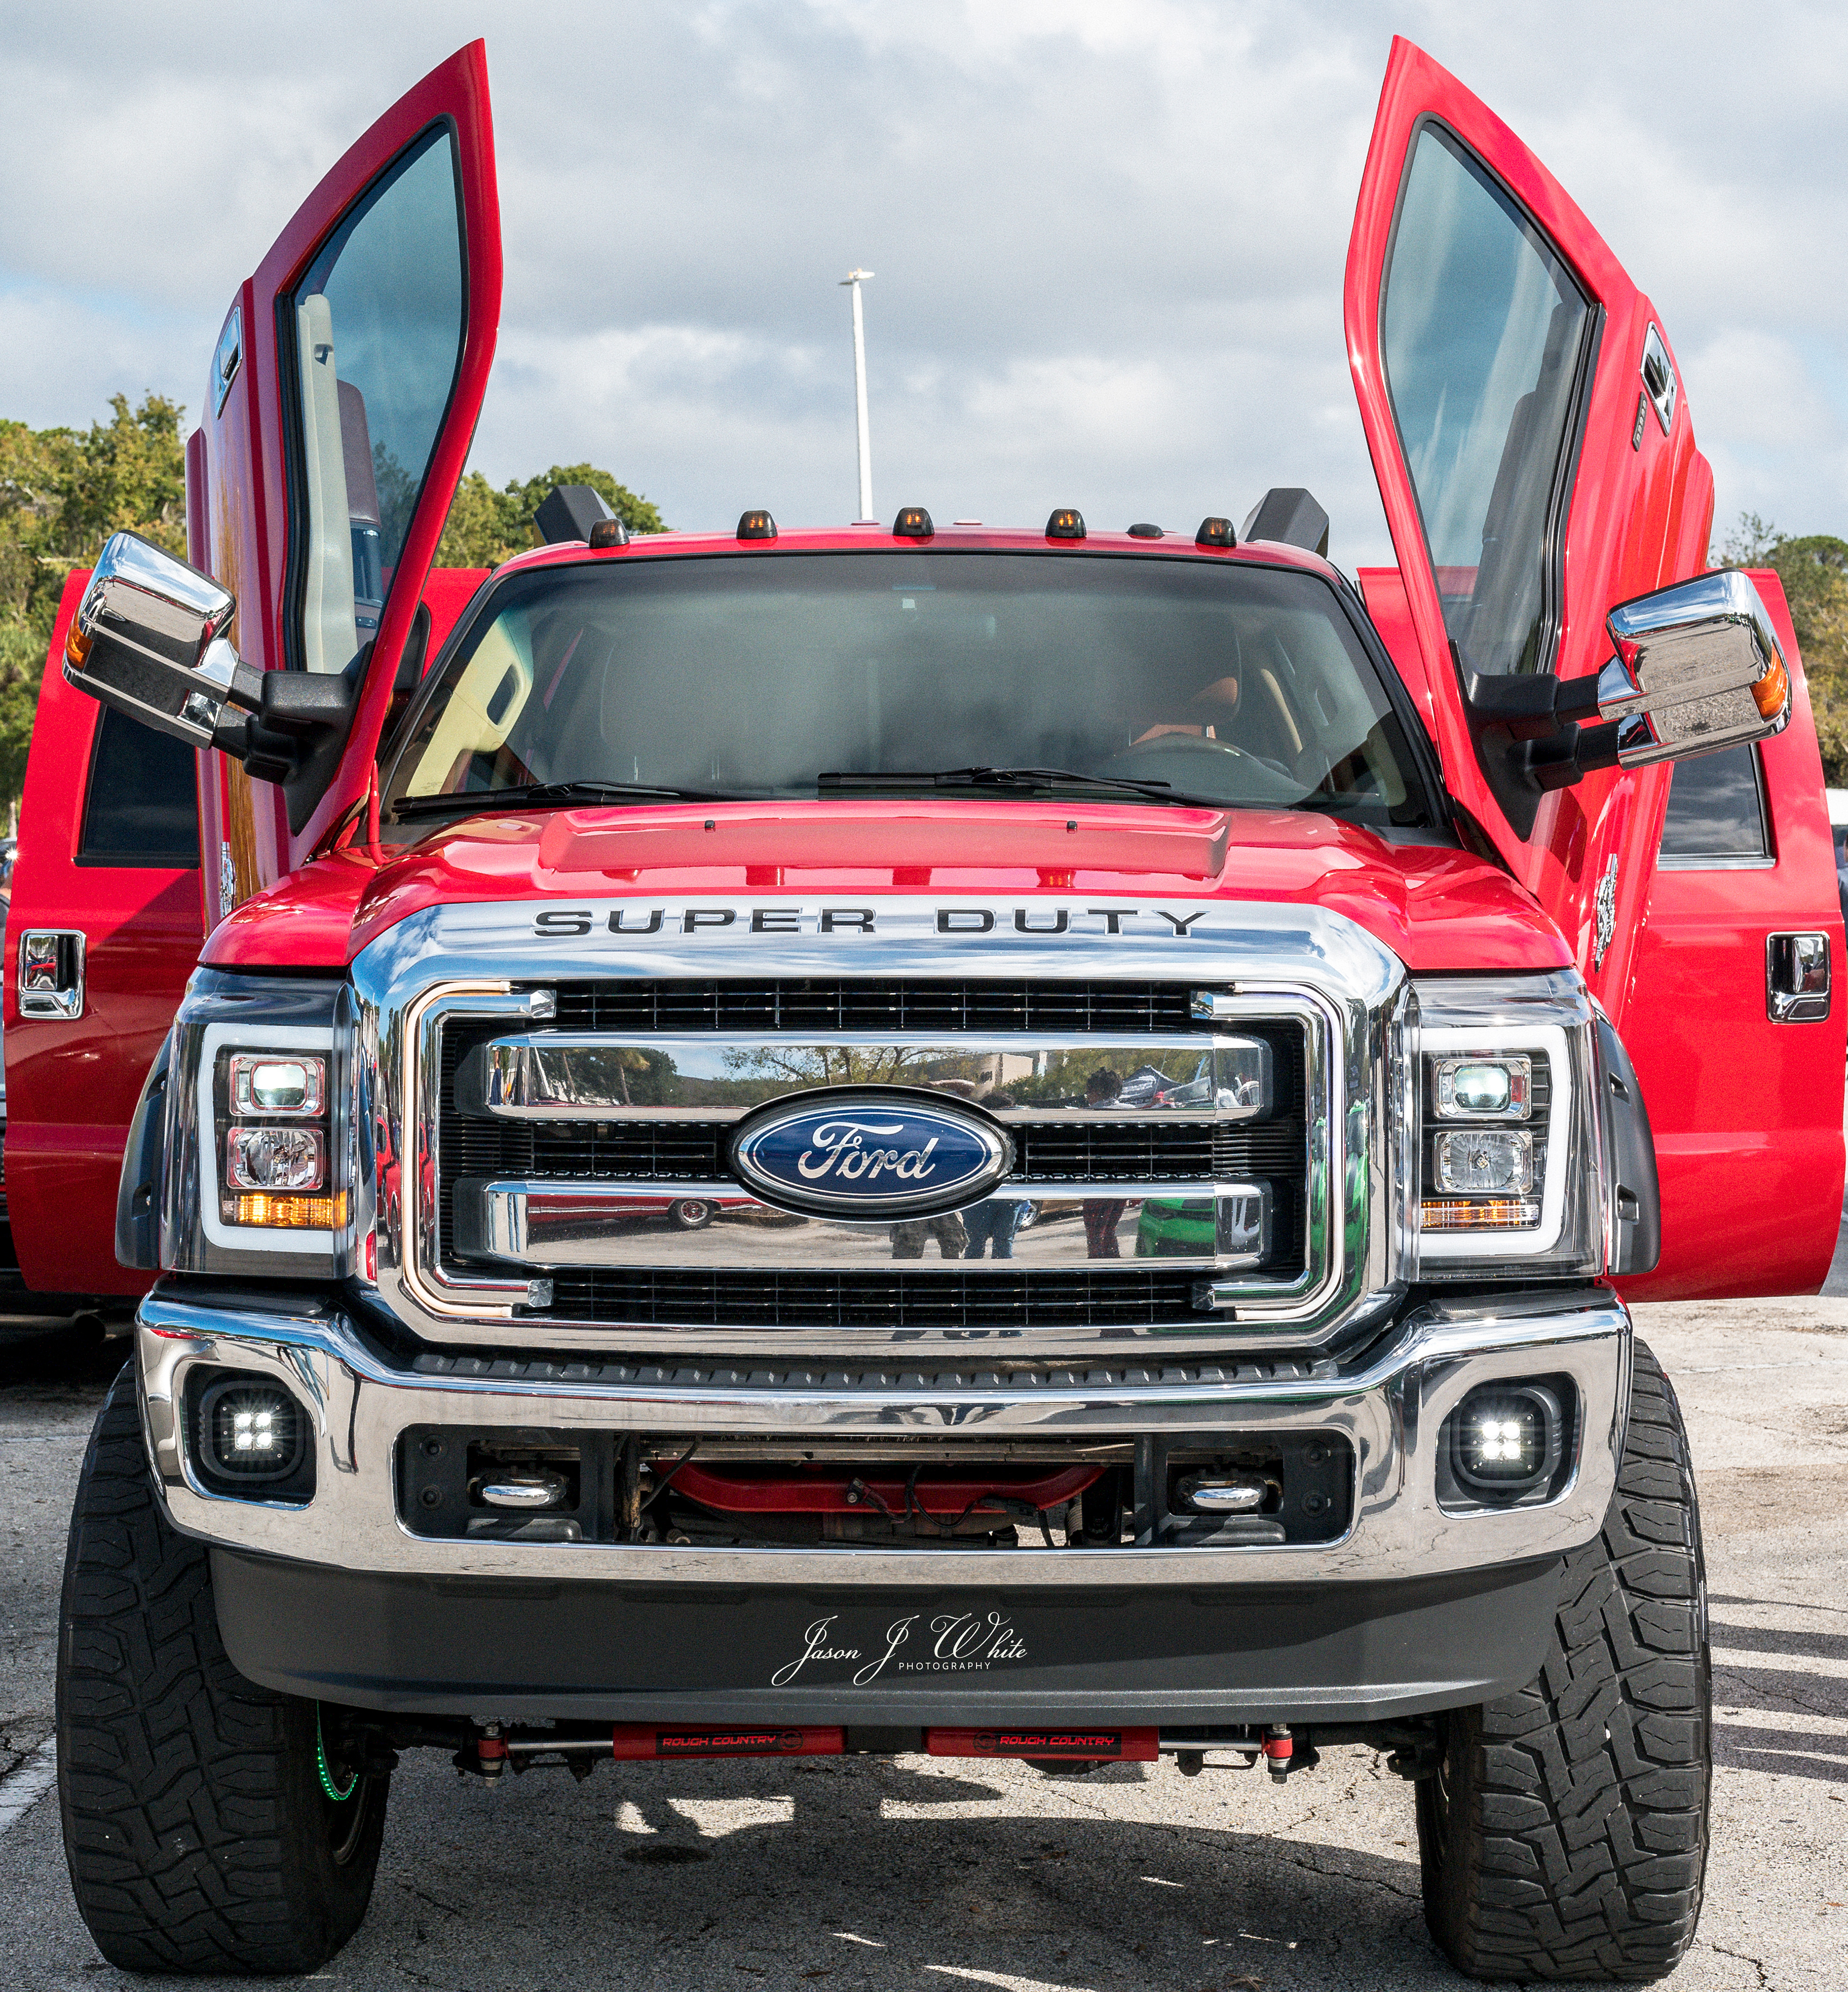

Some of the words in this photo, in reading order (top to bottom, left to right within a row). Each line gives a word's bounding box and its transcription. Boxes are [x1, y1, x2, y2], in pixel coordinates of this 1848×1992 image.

[530, 907, 877, 937] SUPER
[934, 907, 1211, 937] DUTY
[798, 1122, 939, 1178] Ford
[662, 1737, 708, 1747] ROUGH
[712, 1735, 777, 1745] COUNTRY
[1000, 1736, 1046, 1745] ROUGH
[1050, 1737, 1114, 1746] COUNTRY
